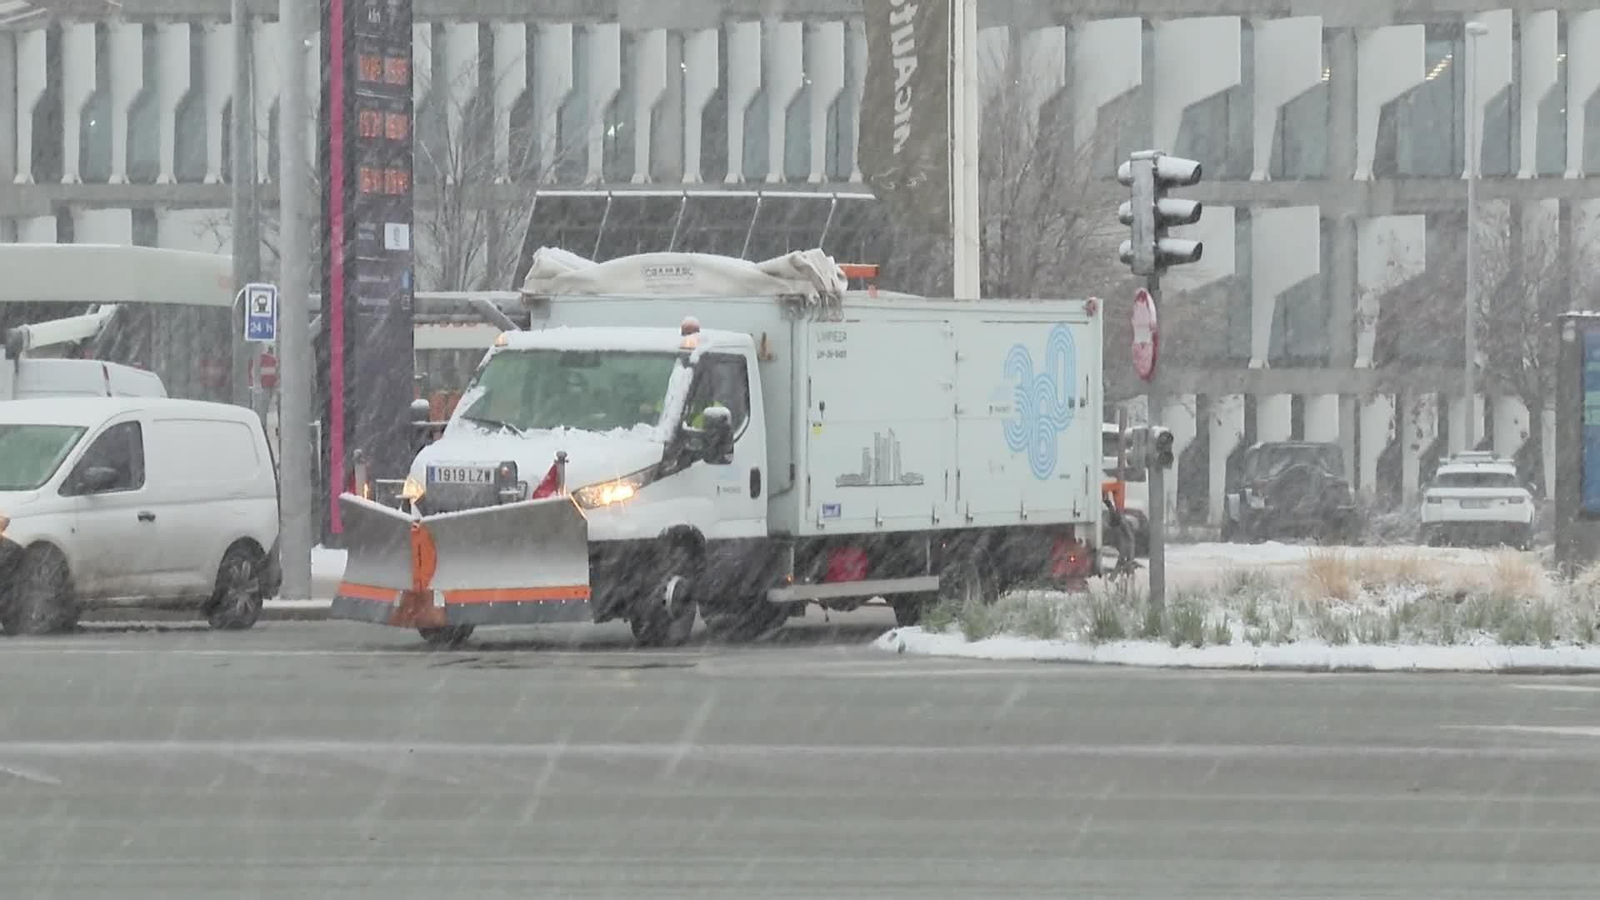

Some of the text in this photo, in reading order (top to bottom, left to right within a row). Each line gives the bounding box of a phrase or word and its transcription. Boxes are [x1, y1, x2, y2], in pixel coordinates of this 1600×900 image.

[250, 321, 273, 333] 24 h
[1003, 322, 1076, 481] 360
[438, 468, 465, 482] 1919
